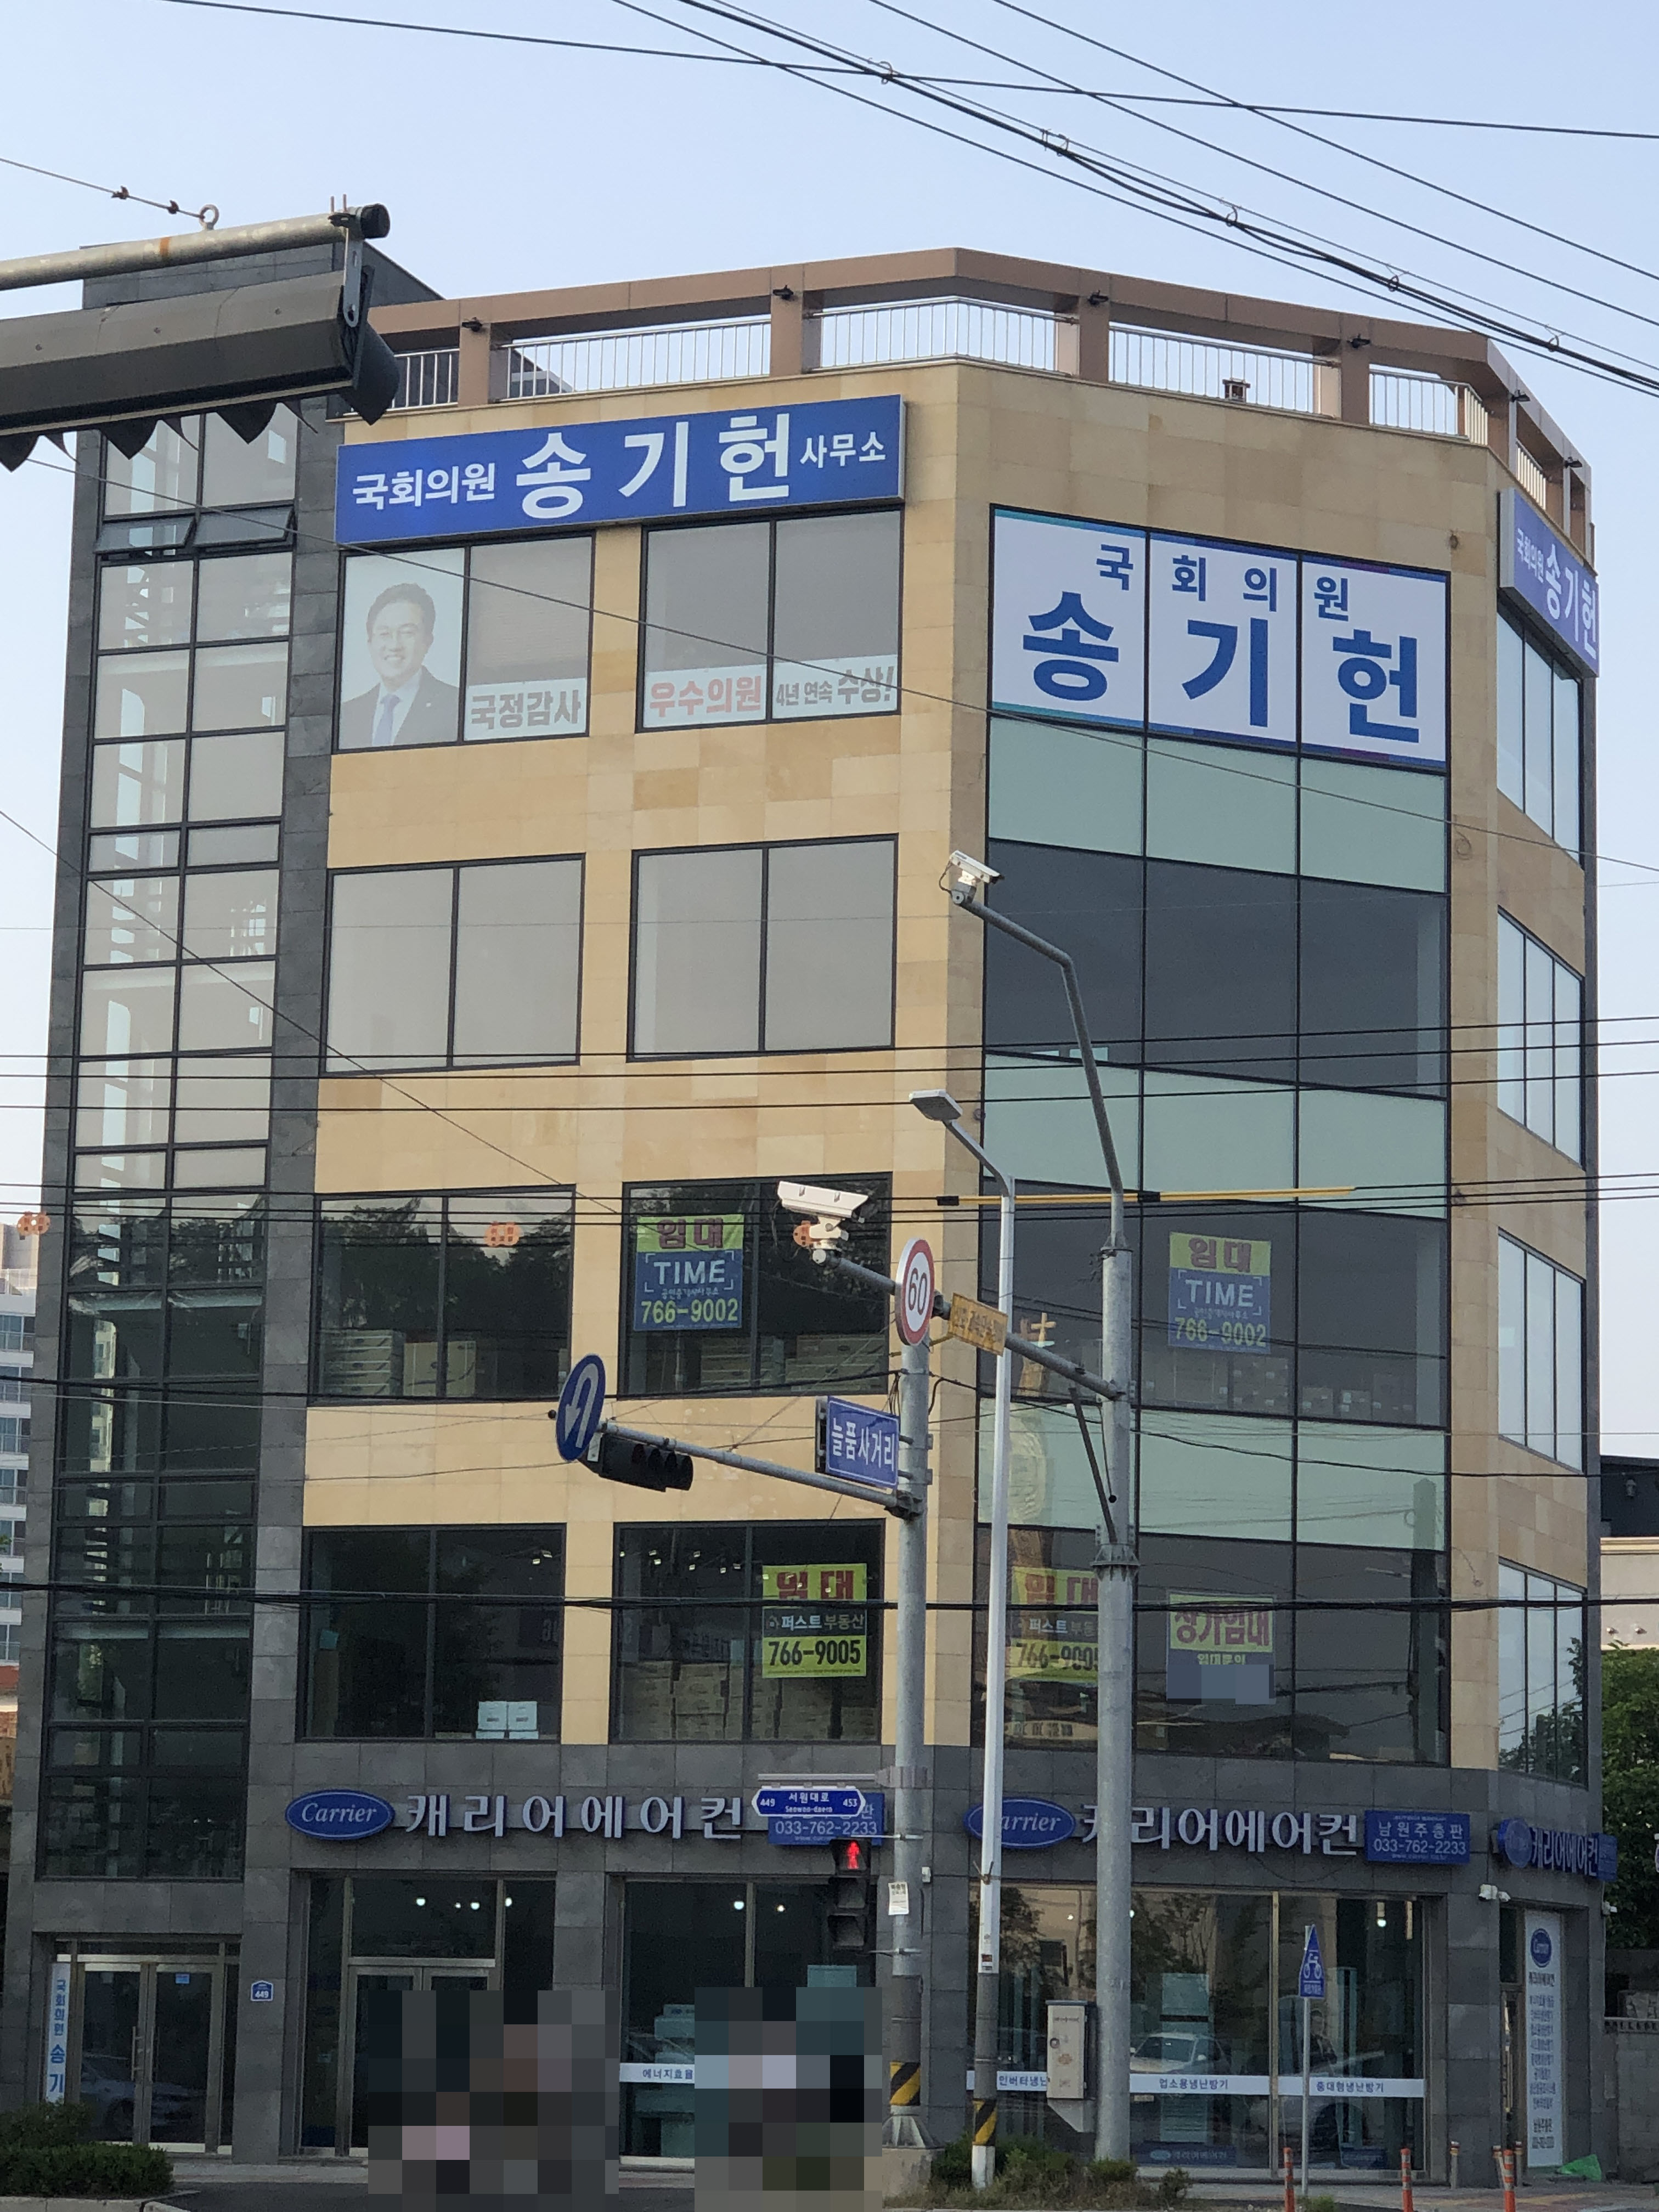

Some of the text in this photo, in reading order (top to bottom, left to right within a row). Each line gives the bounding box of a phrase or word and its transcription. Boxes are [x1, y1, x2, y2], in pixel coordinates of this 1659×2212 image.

[352, 413, 887, 519] 국회의원 송기헌 사무소
[1517, 528, 1544, 583] 국회의원
[1096, 543, 1350, 621] 국회의원
[1545, 543, 1596, 659] 송기헌
[1023, 591, 1419, 744] 송기헌
[649, 666, 894, 718] 우수의원 4년 연속 수상!
[470, 687, 582, 730] 국정감사
[657, 1217, 723, 1249] 임대
[1188, 1237, 1252, 1273] 임대
[653, 1260, 725, 1285] TIME
[908, 1267, 928, 1316] 60
[1184, 1279, 1254, 1307] TIME
[641, 1297, 738, 1324] 766-9002
[1174, 1317, 1267, 1347] 766-9002
[831, 1417, 895, 1472] 늘품사거리
[777, 1570, 854, 1600] 임대
[781, 1614, 865, 1631] 퍼스트 부동산
[1029, 1618, 1068, 1633] 퍼스트
[768, 1639, 861, 1666] 766-9005
[301, 1802, 377, 1822] Carrier
[406, 1795, 742, 1839] 캐리어에어컨
[760, 1798, 775, 1807] 449
[843, 1798, 857, 1807] 453
[775, 1820, 877, 1836] 033-762-2233
[1002, 1813, 1061, 1831] arrier
[1379, 1821, 1463, 1839] 남원주총판
[1373, 1838, 1466, 1855] 033-762-2233
[1532, 1827, 1598, 1877] 캐리어에어컨
[49, 2044, 65, 2094] 송기
[999, 2075, 1047, 2086] 인버터냉난
